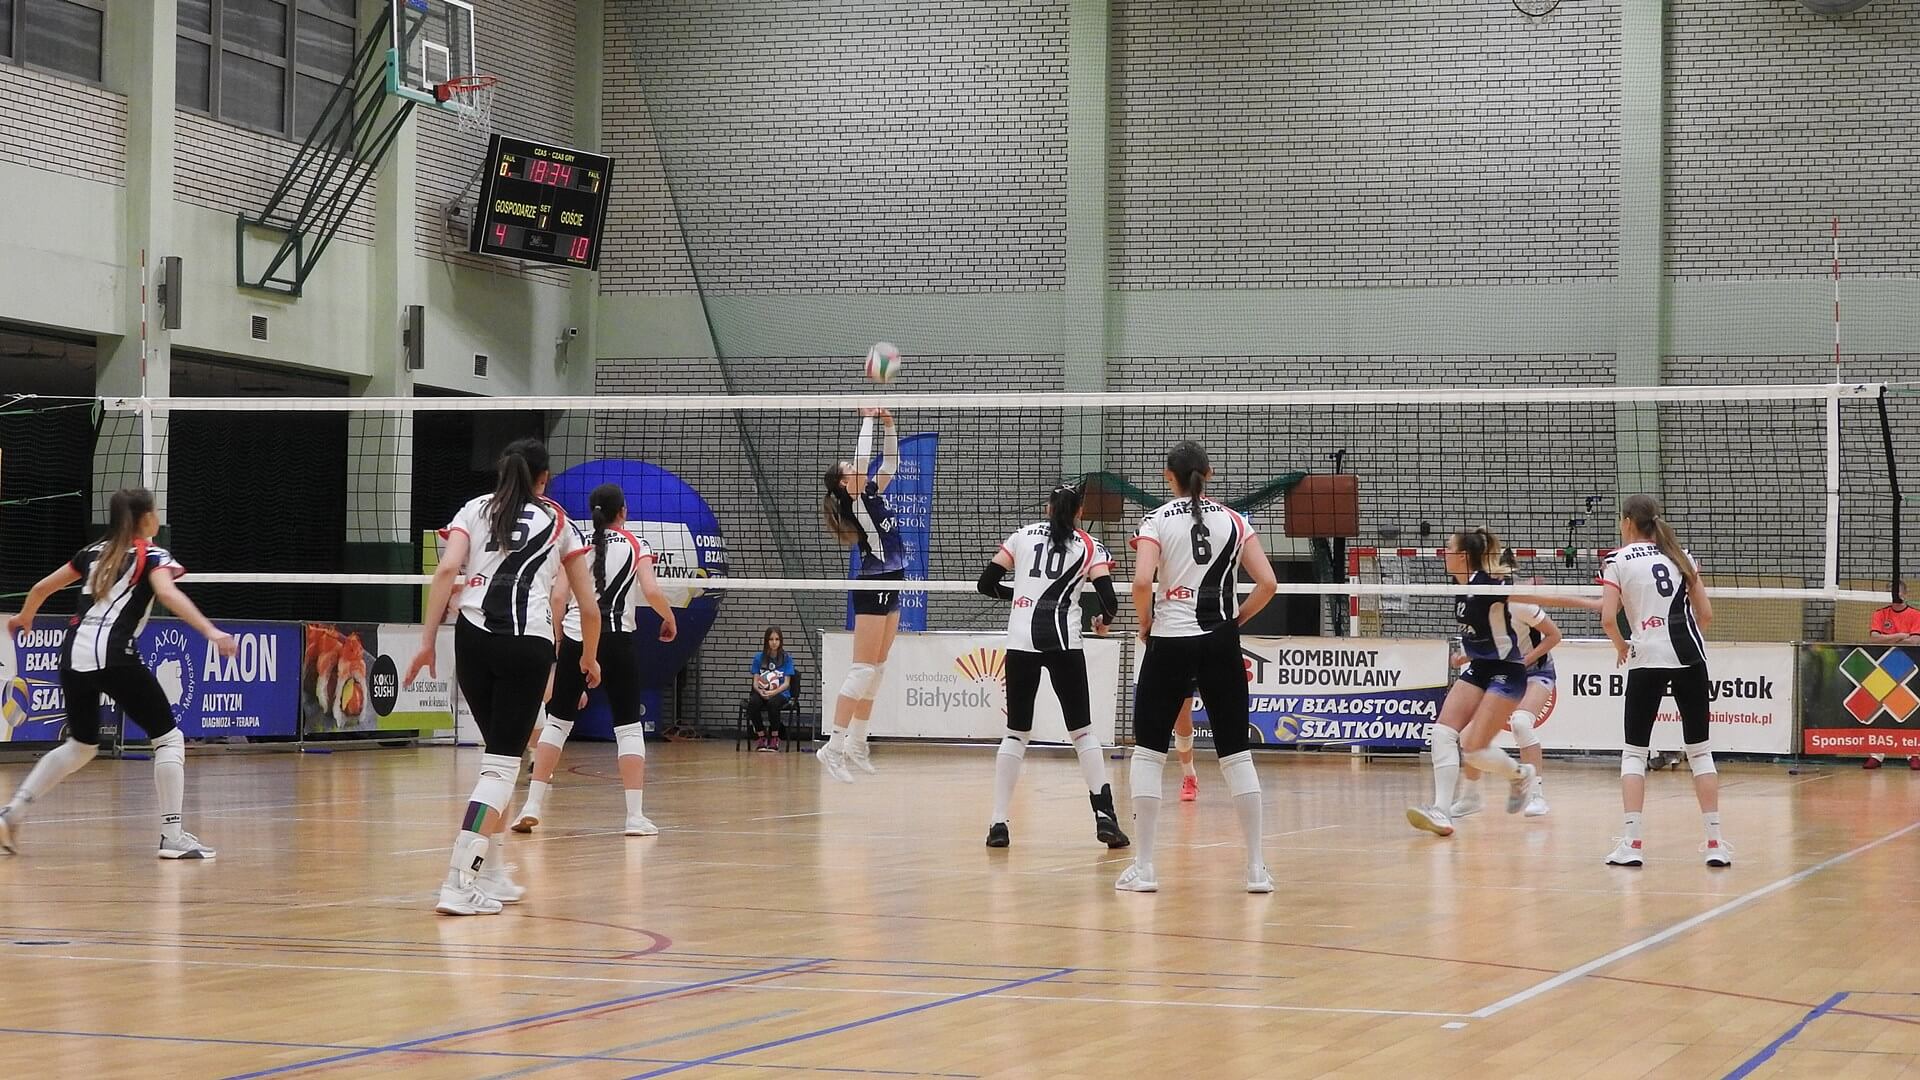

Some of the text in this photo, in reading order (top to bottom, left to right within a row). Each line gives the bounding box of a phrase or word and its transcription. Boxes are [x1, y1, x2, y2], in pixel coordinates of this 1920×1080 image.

[503, 154, 516, 163] FAUL
[534, 148, 547, 157] CZAS
[552, 151, 564, 161] CZAS
[564, 153, 575, 163] GRY
[588, 171, 600, 179] FAUL
[495, 199, 537, 219] GOSPODARZE
[540, 204, 551, 213] SET
[560, 208, 584, 226] GOŚCIE
[495, 224, 507, 245] 4
[570, 237, 590, 259] 10
[1164, 505, 1224, 518] BIAŁTOK
[1190, 523, 1213, 565] 6
[1029, 542, 1067, 580] 10
[1651, 563, 1674, 597] 8
[155, 629, 187, 652] AXON
[25, 653, 62, 671] BIAŁ
[203, 633, 277, 682] AXON
[1279, 649, 1378, 668] KOMBINAT
[373, 673, 395, 685] KOKU
[905, 672, 958, 684] wschodzący
[1278, 668, 1401, 687] BUDOWLANY
[1573, 673, 1602, 697] KS
[374, 685, 395, 698] SUSHI
[905, 686, 992, 712] Białystok
[202, 693, 242, 712] AUTYZM
[1301, 698, 1438, 721] BIAŁOSTOCKĄ
[201, 716, 231, 728] DIAGNOZA
[236, 716, 260, 727] TERAPIA
[1300, 716, 1434, 746] SIATKÓWKĘ
[1812, 734, 1920, 749] Sponsor BAS, tel.
